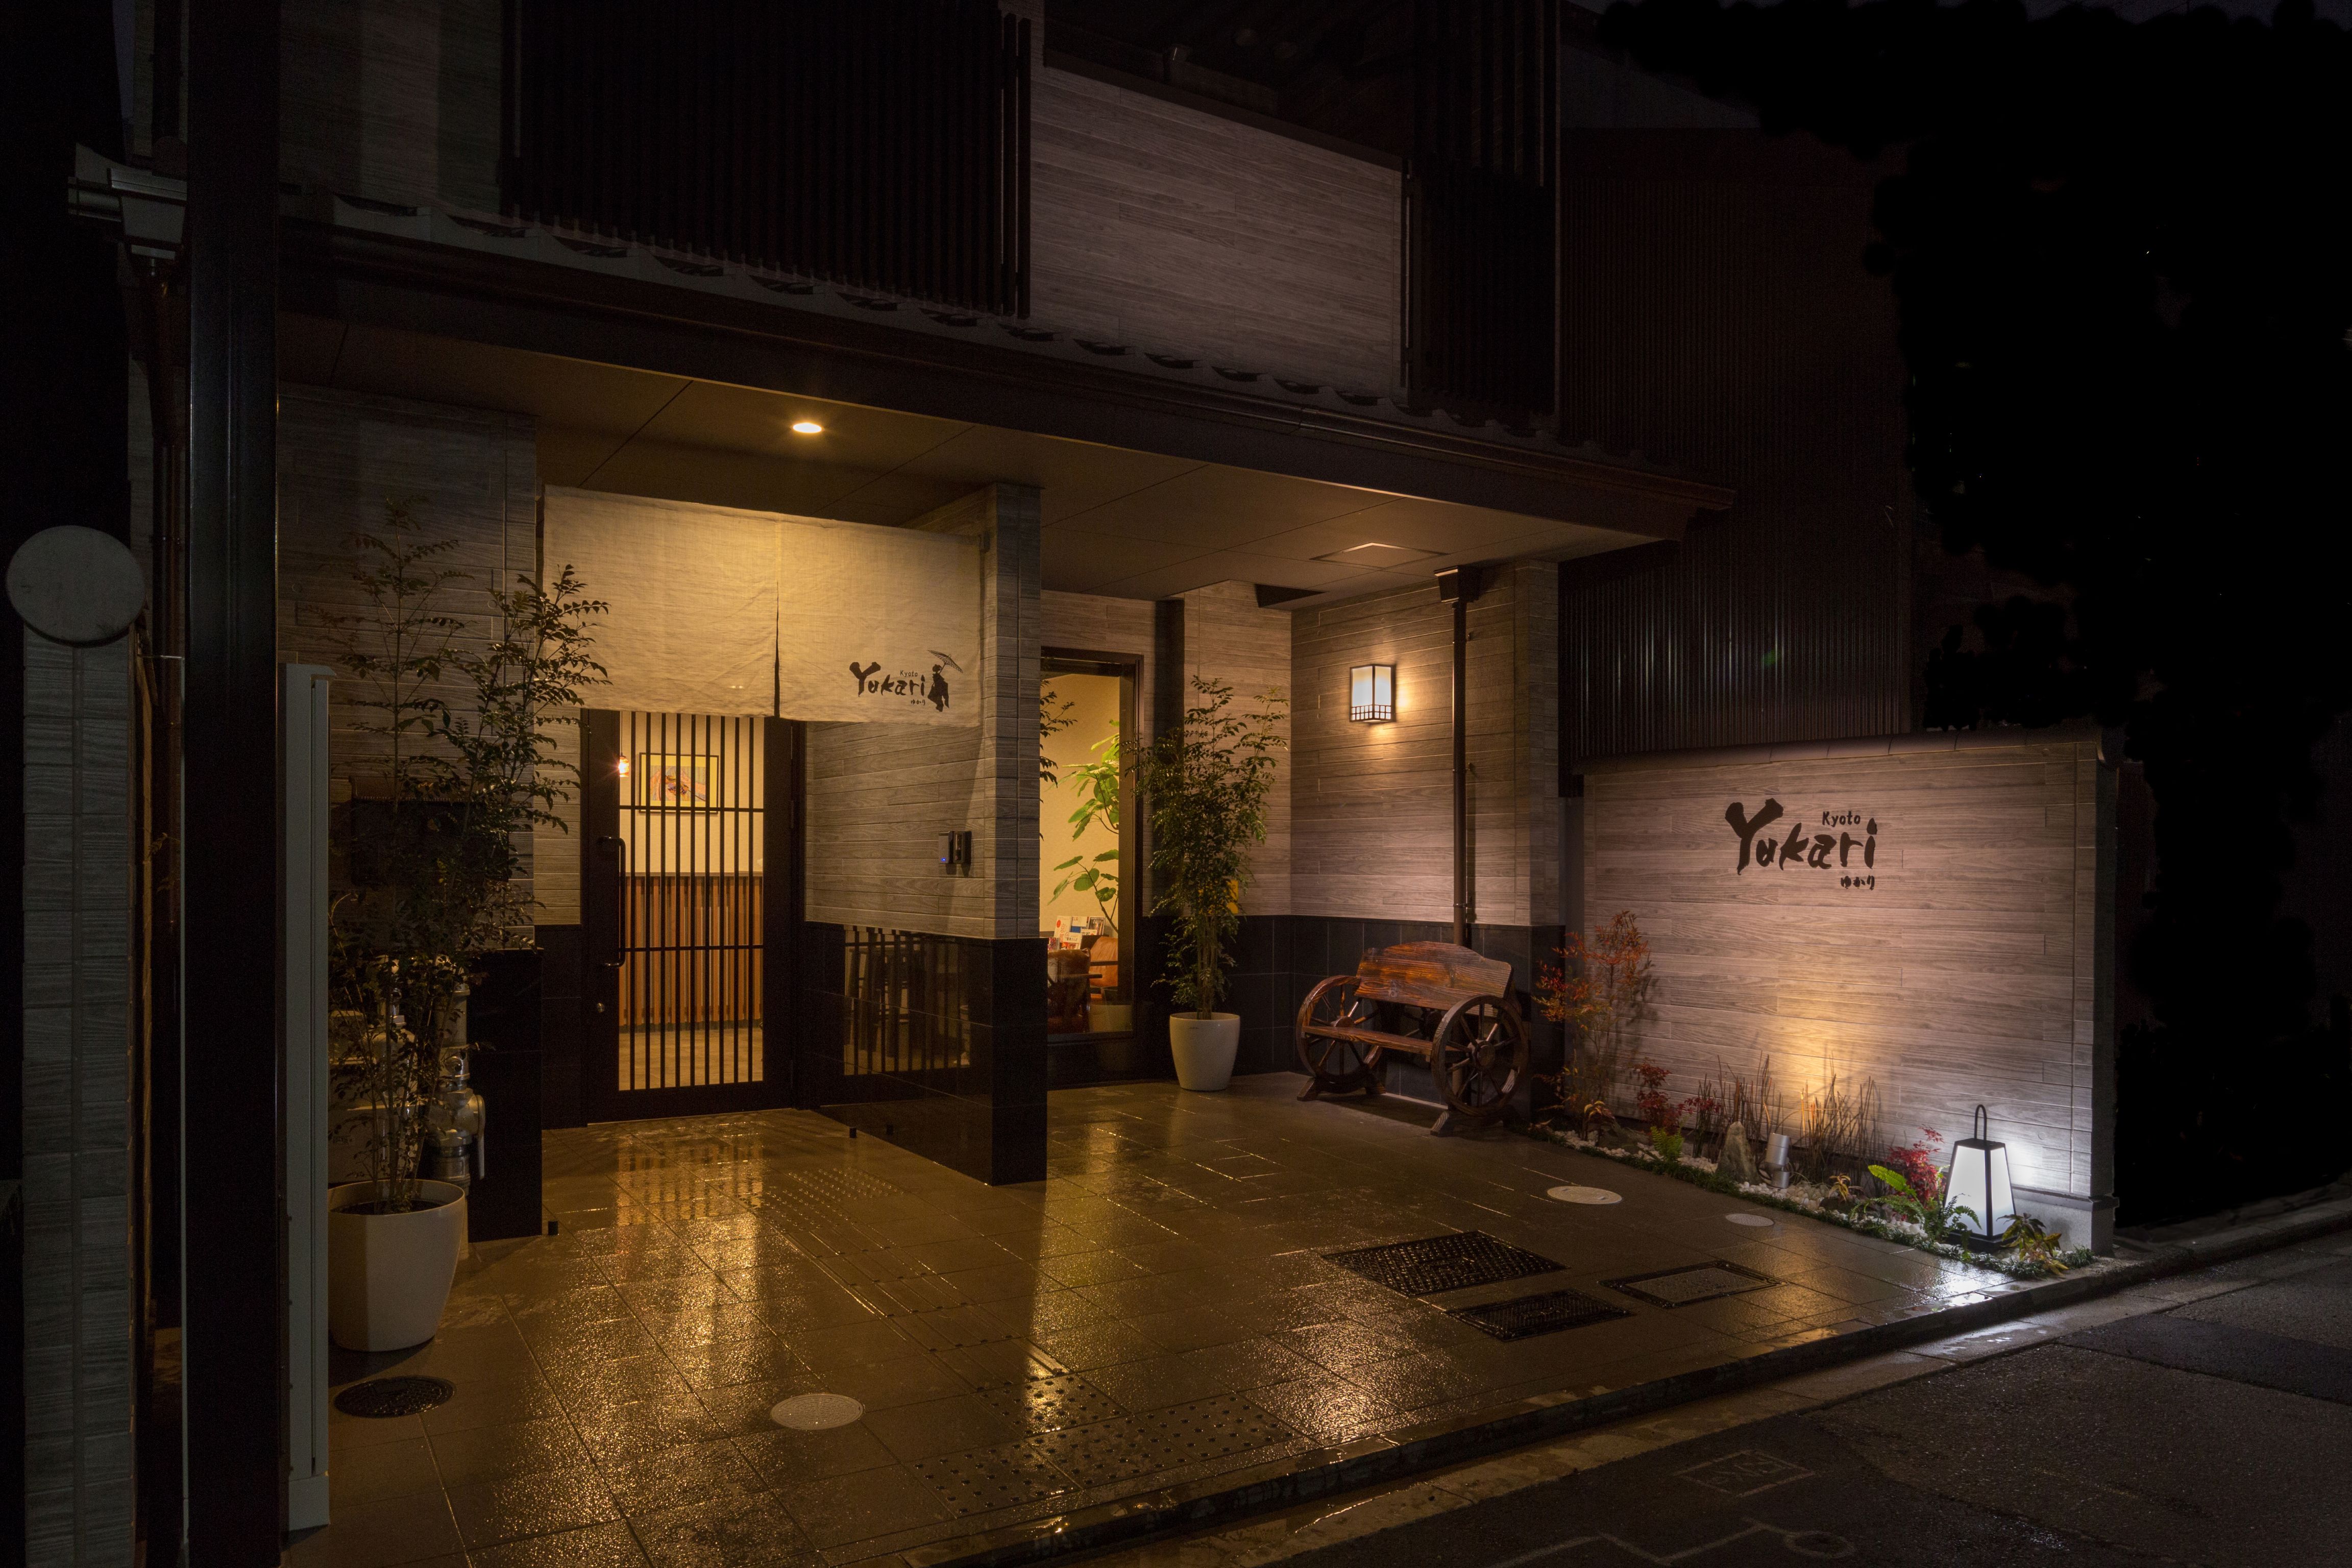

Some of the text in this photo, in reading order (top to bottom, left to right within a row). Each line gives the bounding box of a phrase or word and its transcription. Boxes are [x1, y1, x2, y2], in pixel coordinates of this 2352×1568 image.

[849, 662, 925, 697] Yukari
[1822, 811, 1860, 827] Kyoto
[1725, 798, 1877, 875] Yukari
[1841, 875, 1875, 890] ゆかり
